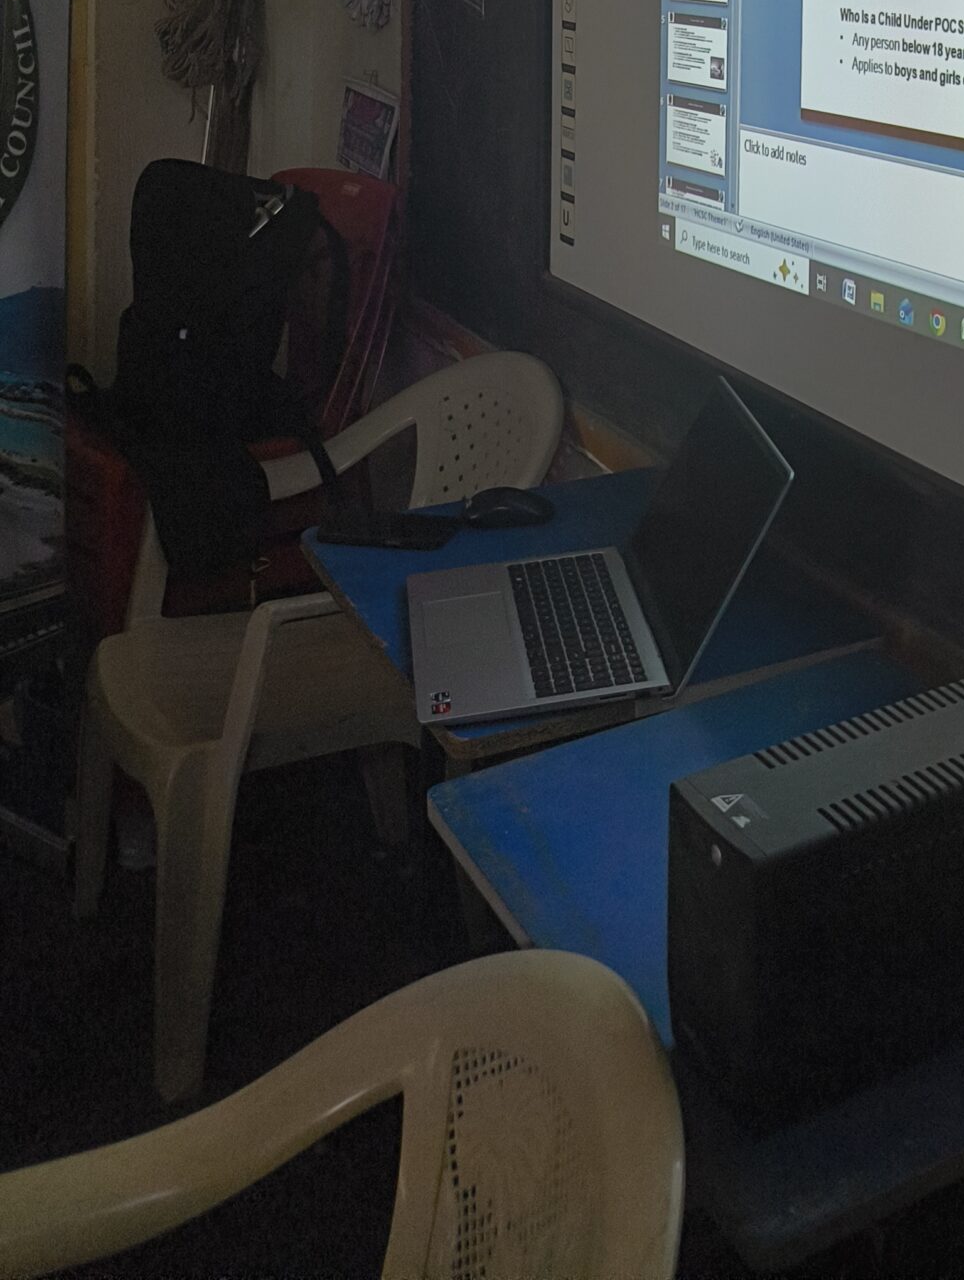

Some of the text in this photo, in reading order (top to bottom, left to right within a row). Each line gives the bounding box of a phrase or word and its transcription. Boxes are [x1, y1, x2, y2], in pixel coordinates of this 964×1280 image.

[840, 8, 860, 23] Who
[861, 9, 869, 23] Is
[870, 13, 876, 24] a
[878, 11, 902, 28] Child
[903, 14, 933, 31] Under
[852, 32, 870, 49] Any
[870, 37, 900, 52] person
[902, 38, 930, 55] below
[931, 41, 943, 57] 18
[852, 56, 883, 74] Applies
[884, 61, 893, 75] to
[894, 63, 918, 80] boys
[919, 67, 938, 82] and
[939, 69, 961, 87] girls
[0, 14, 36, 178] COUNCIL
[744, 139, 807, 166] Click to add notes
[750, 225, 770, 240] English
[692, 235, 750, 265] Type here to search
